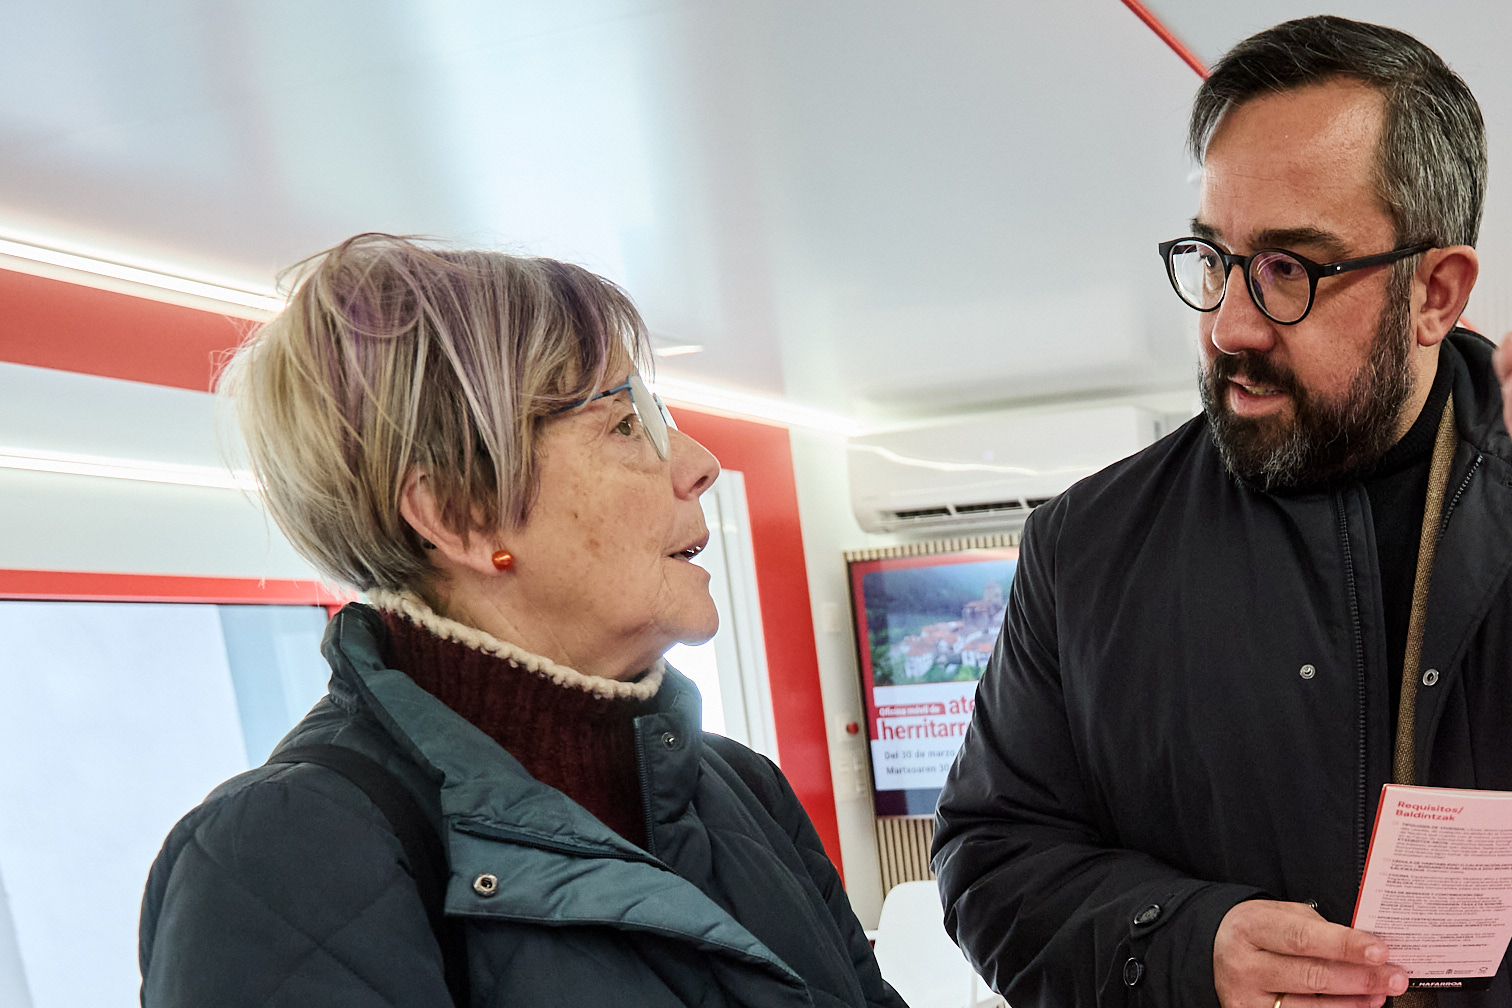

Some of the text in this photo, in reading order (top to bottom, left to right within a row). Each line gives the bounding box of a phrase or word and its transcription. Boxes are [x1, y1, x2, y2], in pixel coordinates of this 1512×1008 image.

[882, 718, 968, 740] herritarr
[884, 748, 955, 760] Del 30 de marzo
[1397, 800, 1464, 815] Requisitos/
[1395, 809, 1456, 821] Baldintzak
